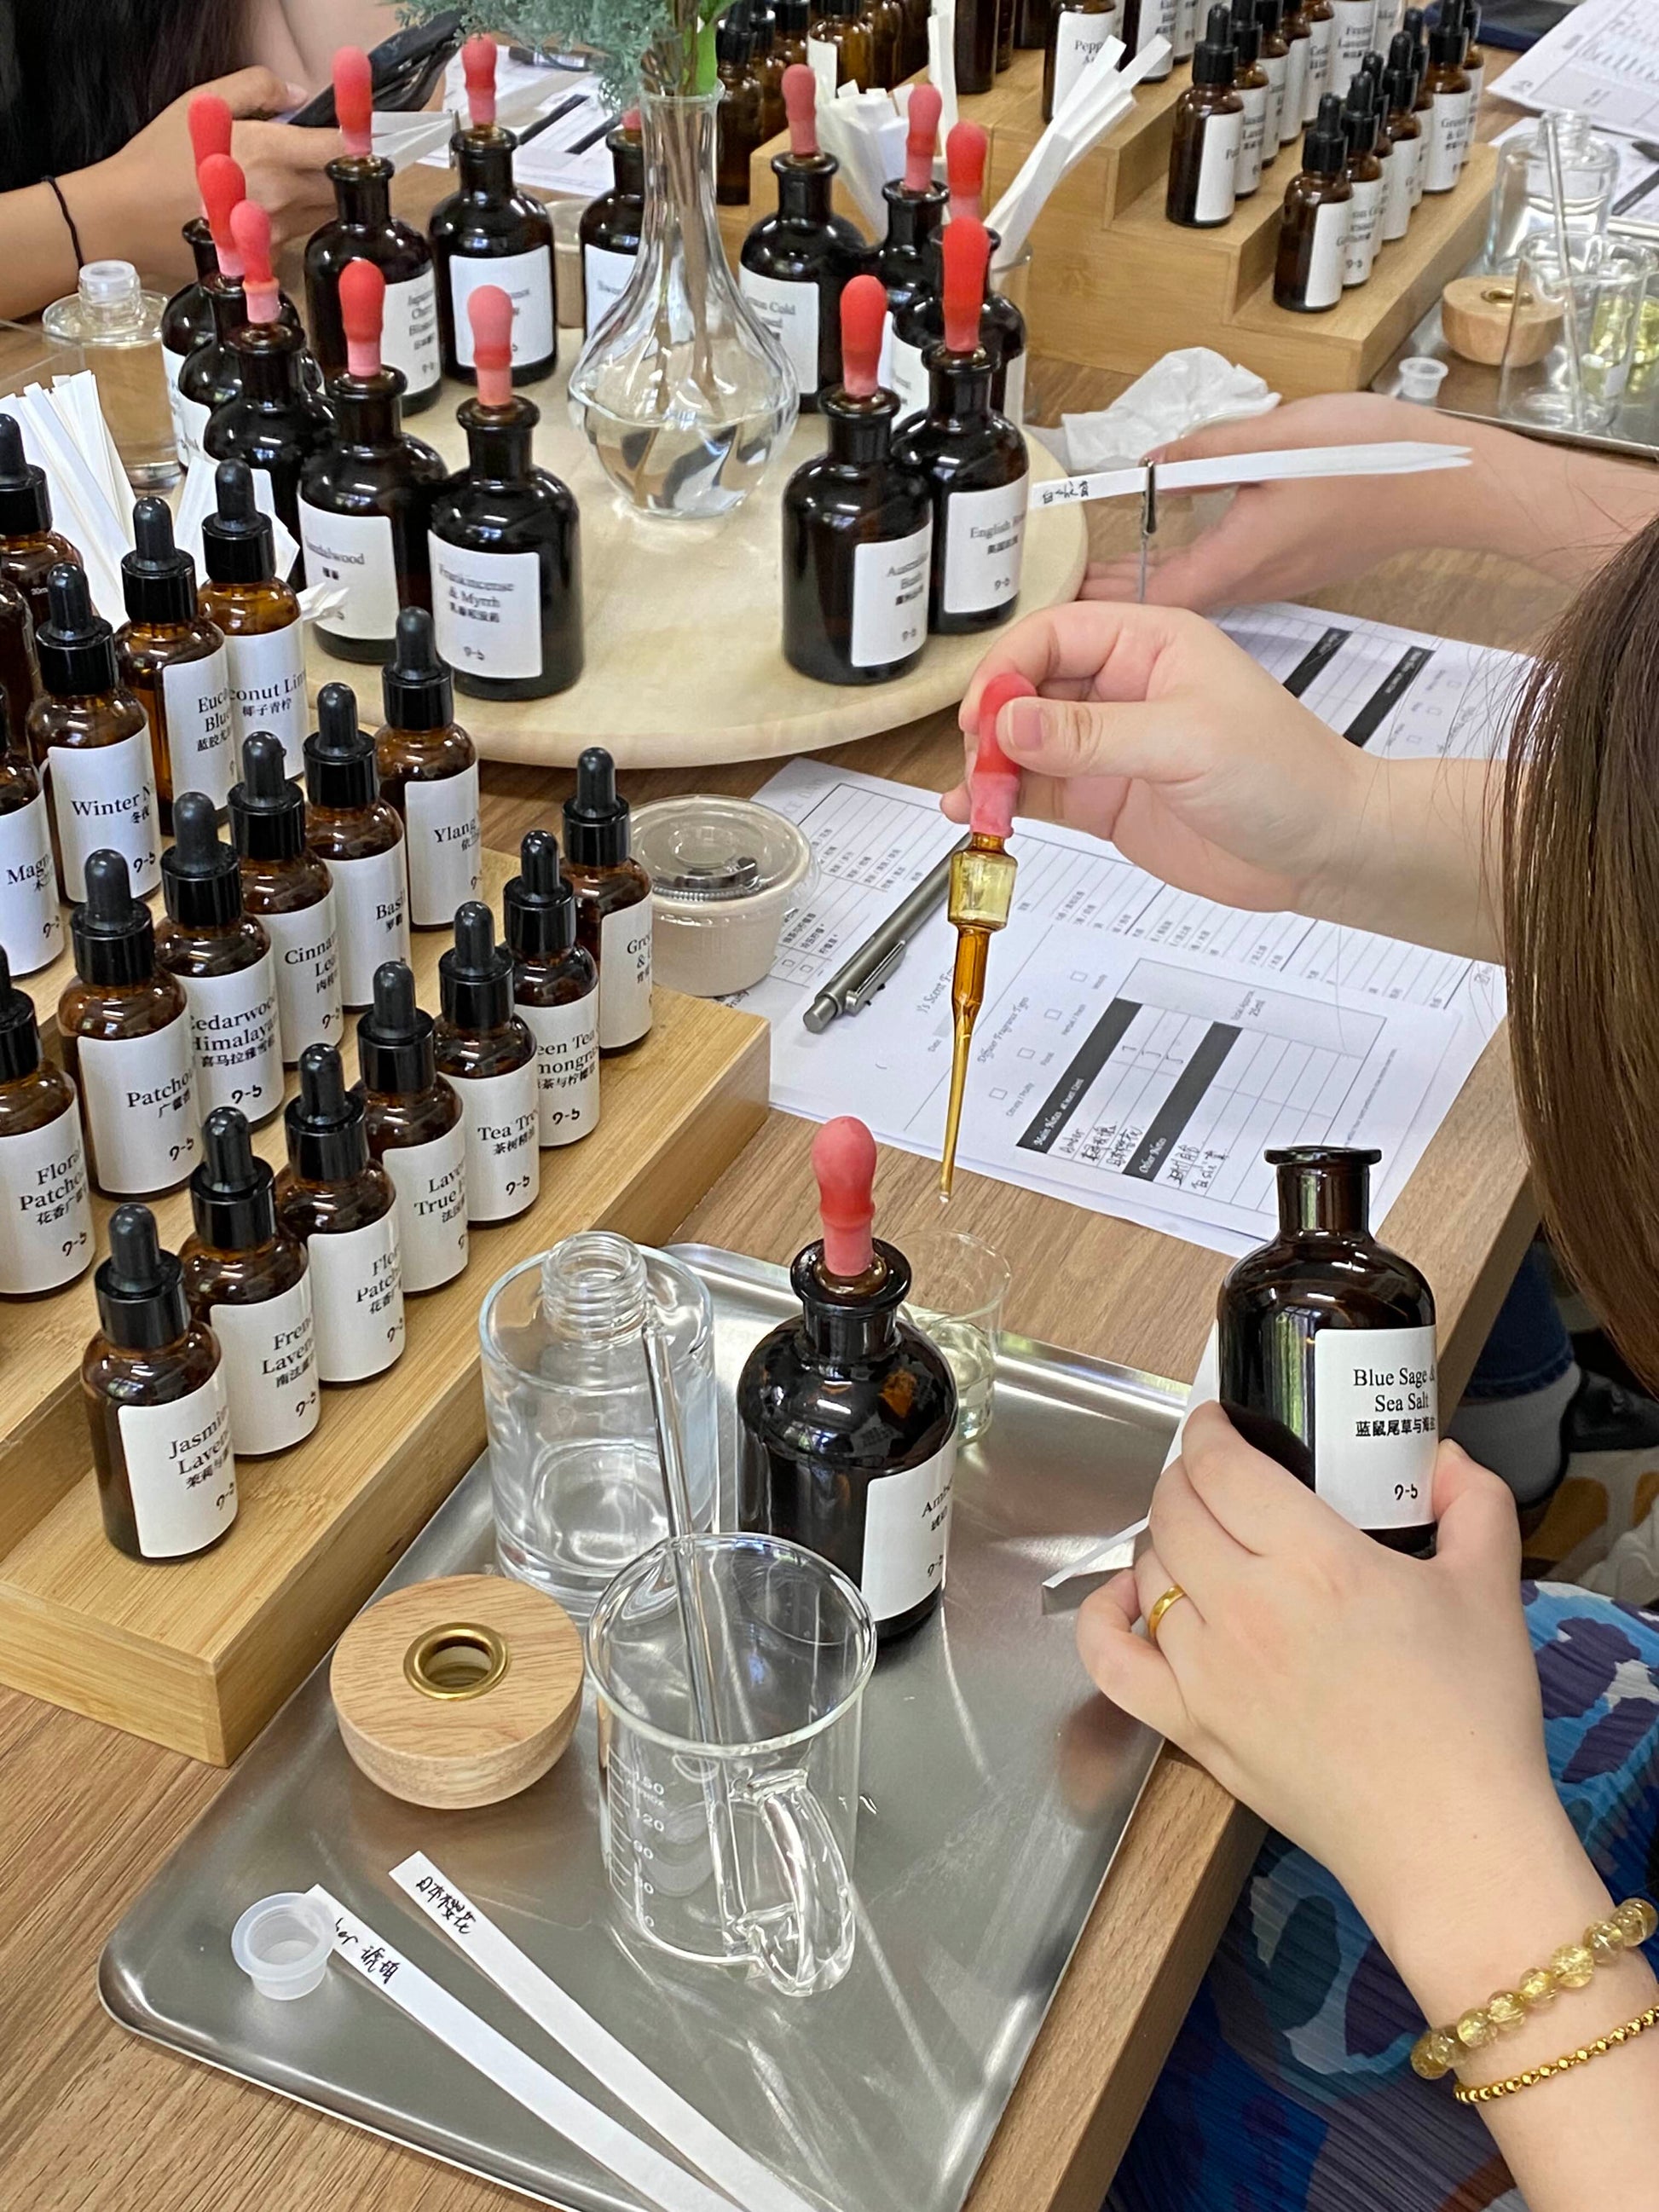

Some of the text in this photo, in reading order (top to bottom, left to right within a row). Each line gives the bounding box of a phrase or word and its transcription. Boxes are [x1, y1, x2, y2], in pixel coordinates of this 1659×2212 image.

[228, 684, 280, 702] conut
[71, 793, 141, 817] Winter
[537, 1042, 568, 1057] een
[477, 1125, 512, 1141] Tea
[413, 1189, 458, 1217] True
[1353, 1369, 1395, 1387] Blue
[1399, 1366, 1428, 1389] Sage
[1374, 1391, 1430, 1412] Sea Salt
